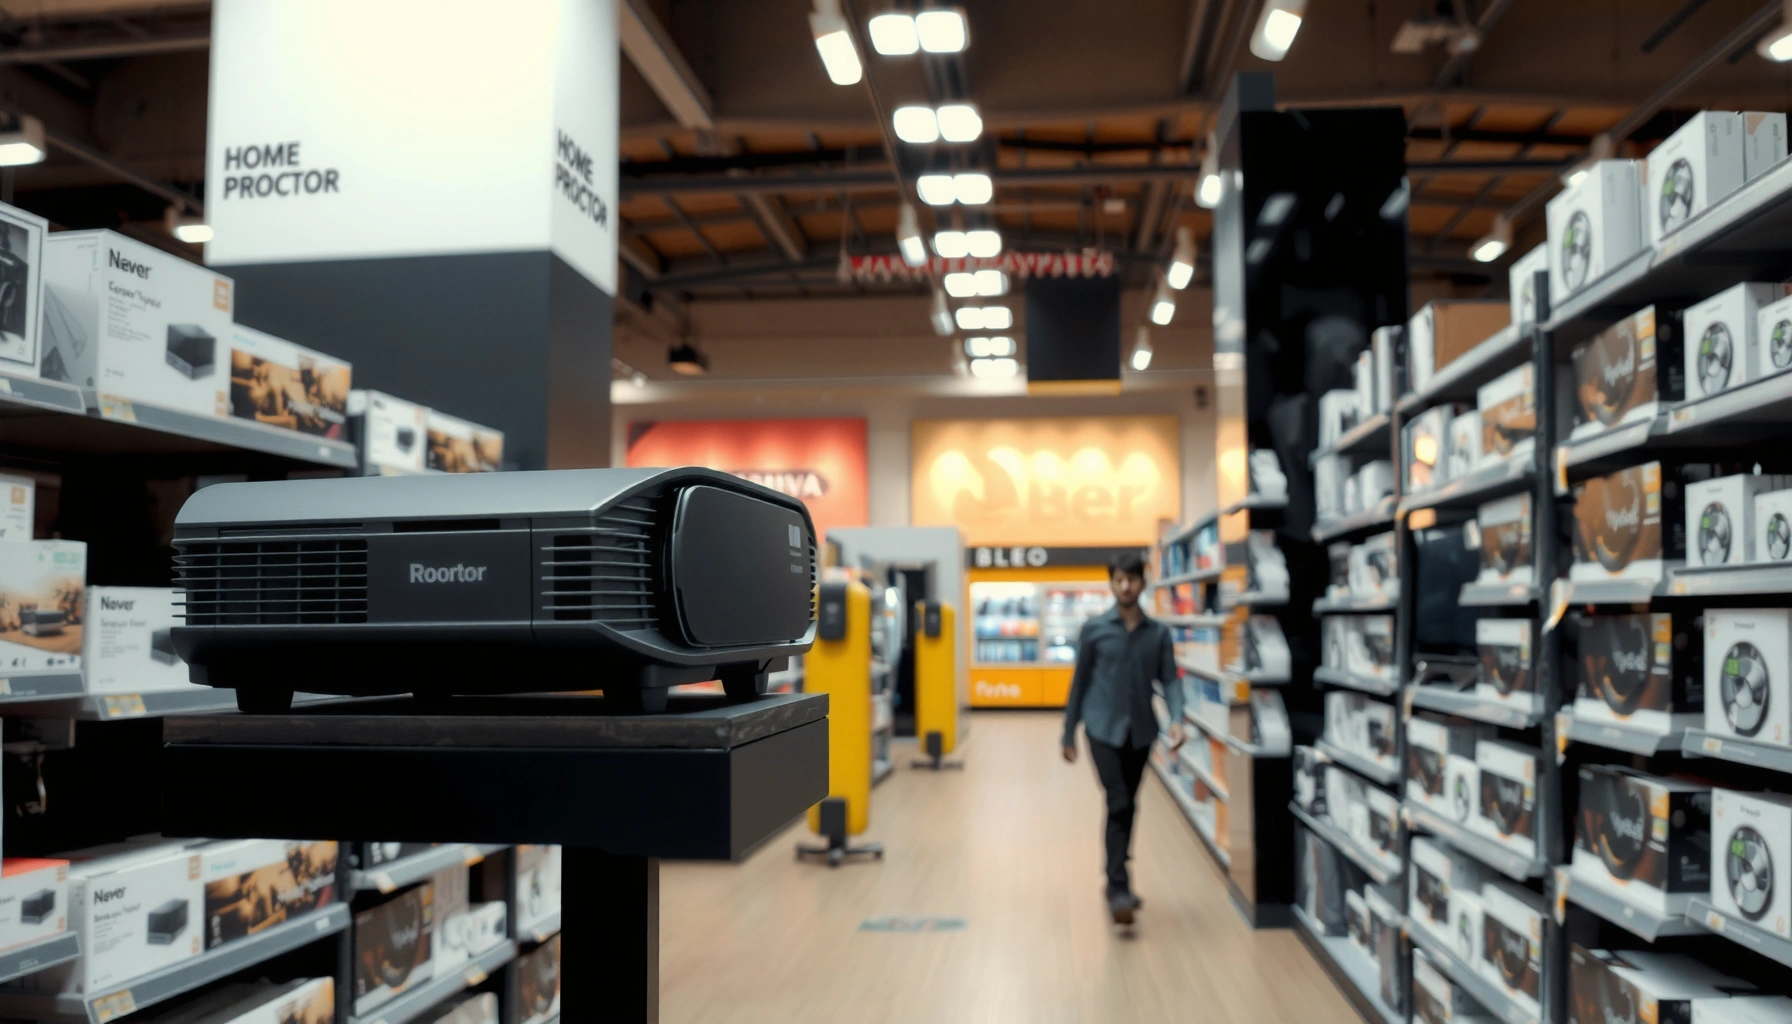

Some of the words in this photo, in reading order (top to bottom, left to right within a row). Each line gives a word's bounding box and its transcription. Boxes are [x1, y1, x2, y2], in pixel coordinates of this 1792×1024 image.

[224, 141, 300, 171] HOME
[557, 128, 594, 186] HOME
[223, 168, 340, 200] PROCTOR
[555, 162, 608, 232] PROCTOR
[975, 546, 1048, 567] BLEO
[409, 563, 487, 583] Roortor
